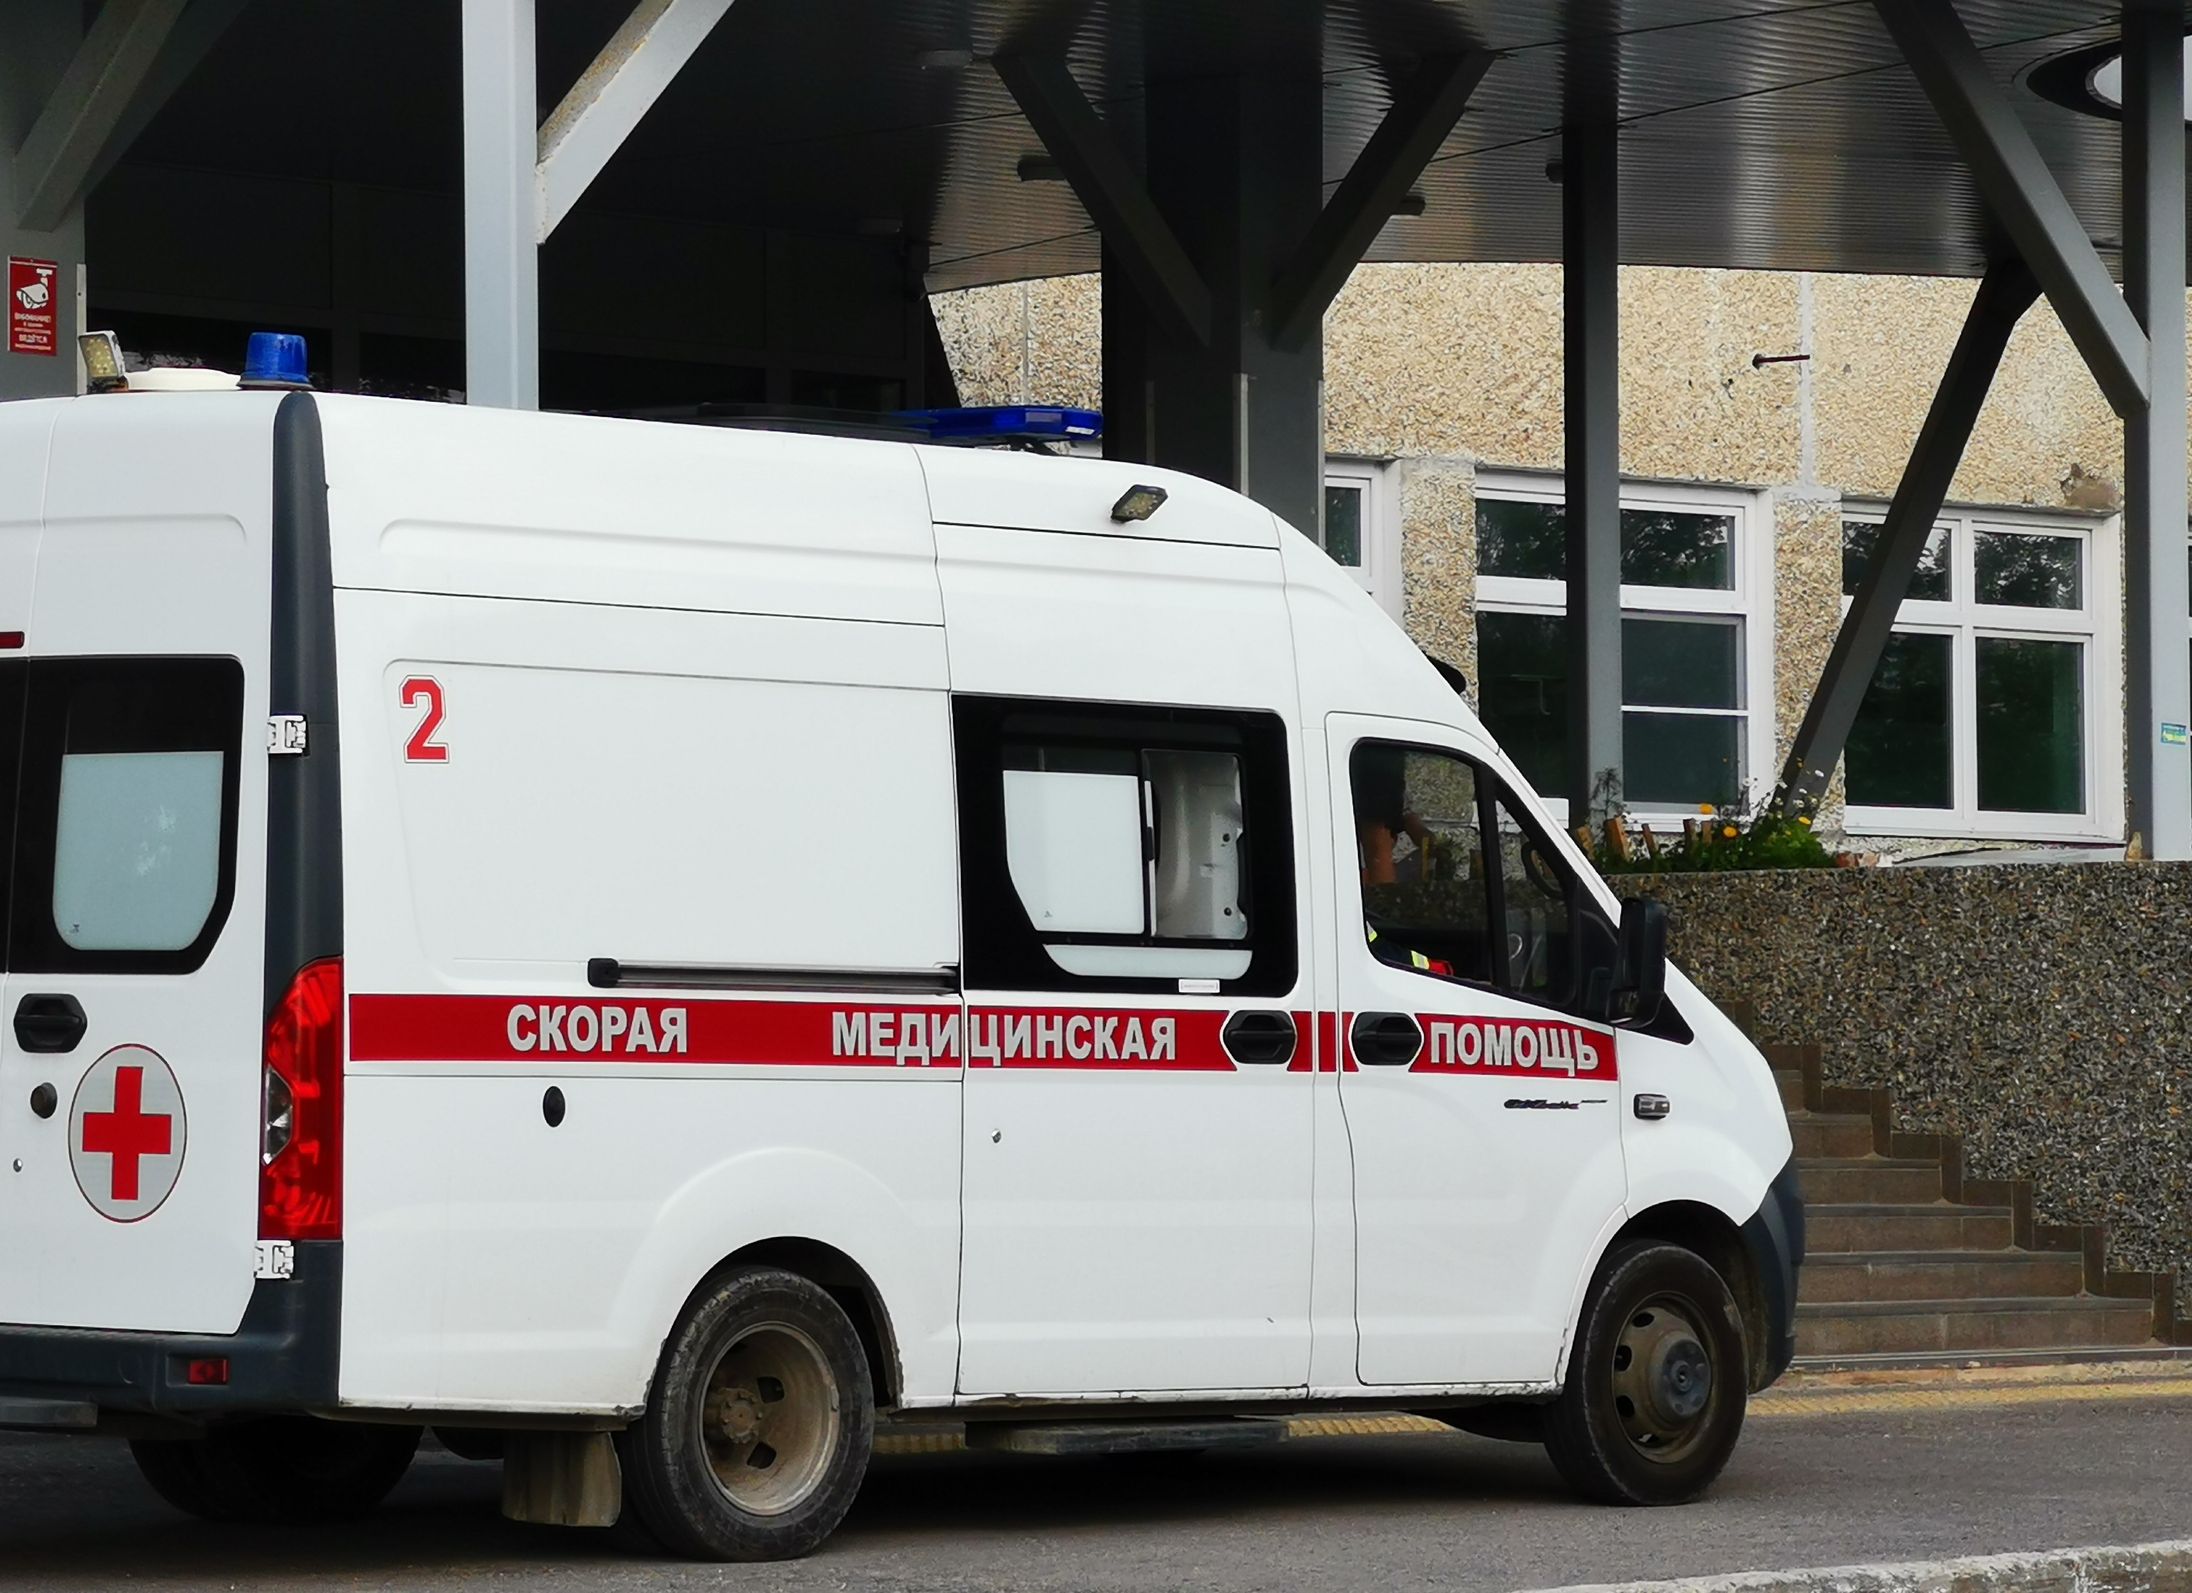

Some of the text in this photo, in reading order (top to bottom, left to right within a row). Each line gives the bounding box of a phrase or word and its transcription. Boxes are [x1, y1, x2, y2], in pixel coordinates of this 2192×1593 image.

[399, 675, 449, 764] 2
[507, 1004, 1599, 1077] СКОРАЯ МЕДИЦИНСКАЯ ПОМОЩЬ
